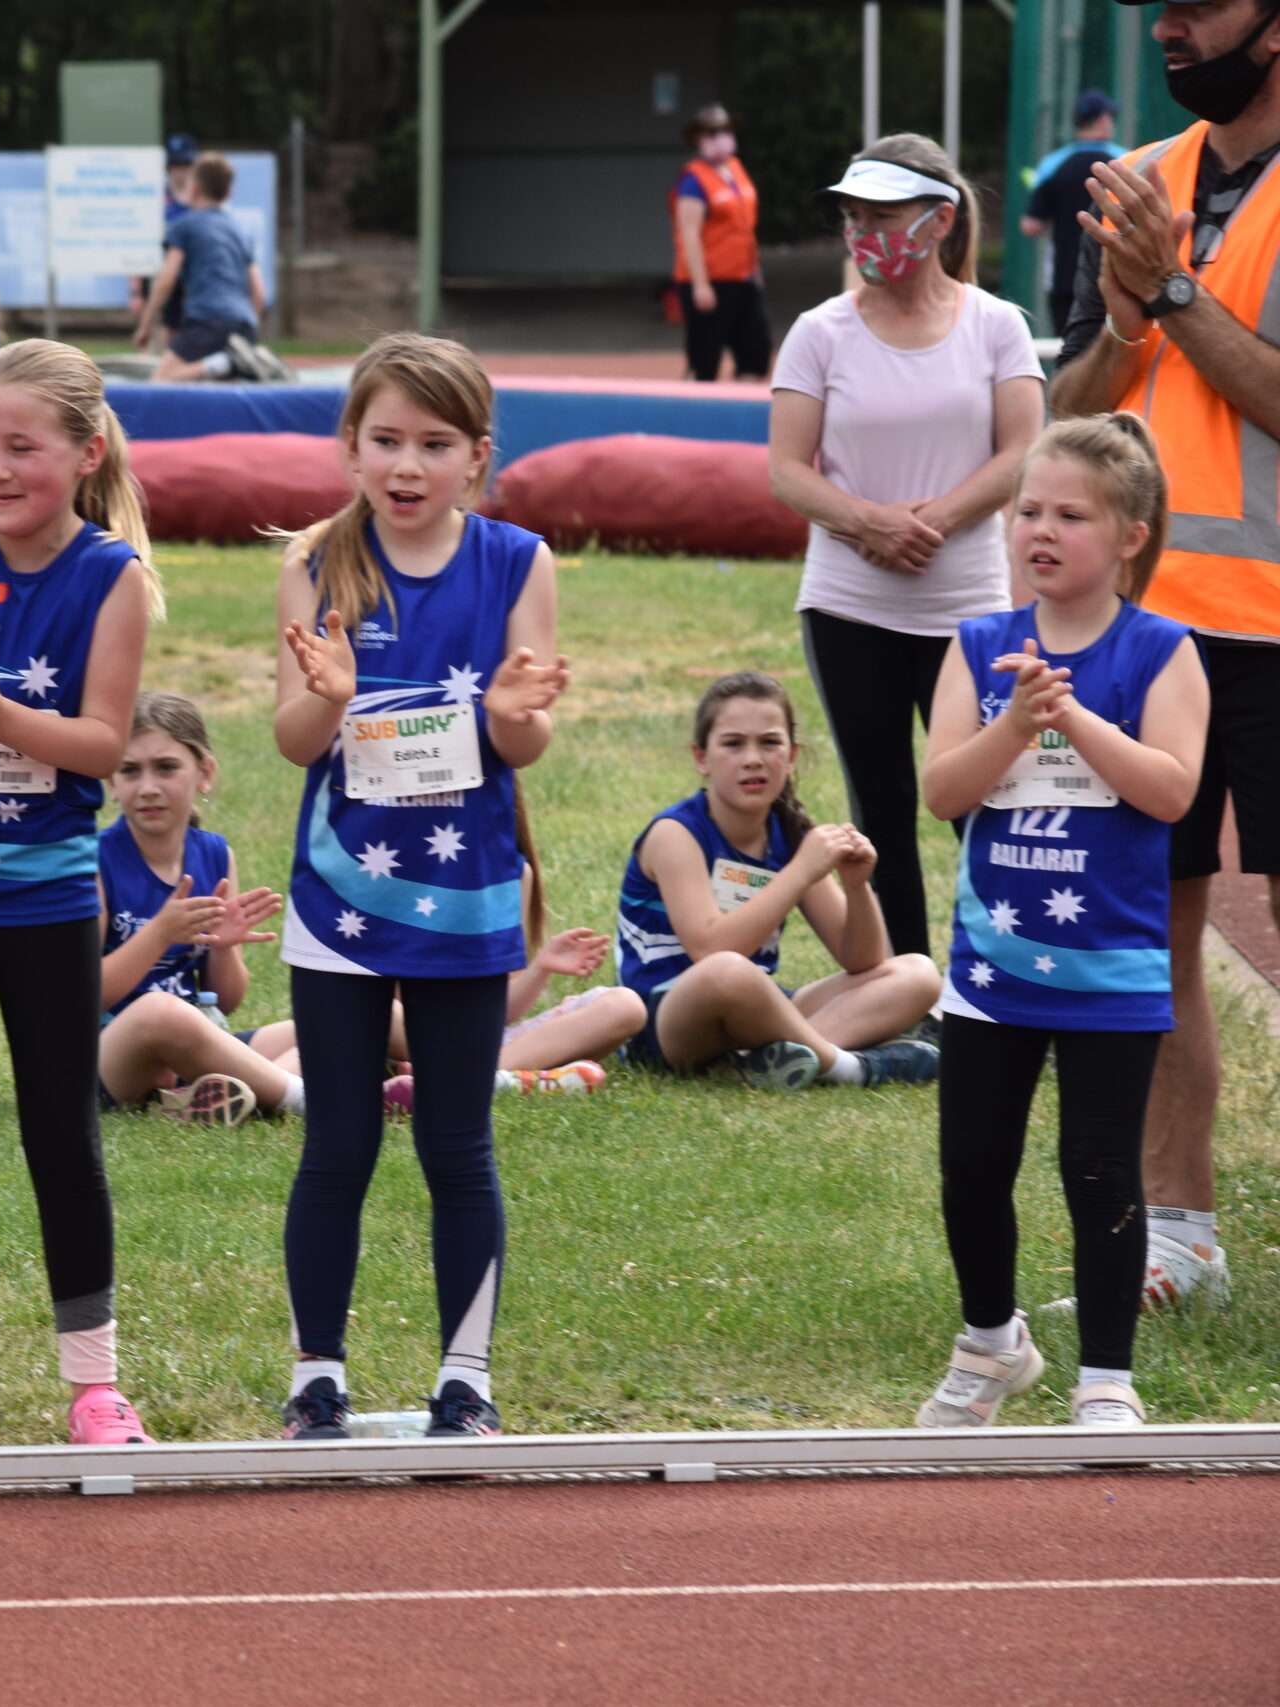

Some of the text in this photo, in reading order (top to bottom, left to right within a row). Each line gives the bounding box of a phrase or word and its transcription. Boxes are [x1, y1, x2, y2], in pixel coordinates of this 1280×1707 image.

[354, 711, 459, 742] SUBWAY
[394, 747, 441, 762] Edith.E
[1037, 755, 1077, 766] Ella.C
[989, 841, 1089, 873] BALLARAT
